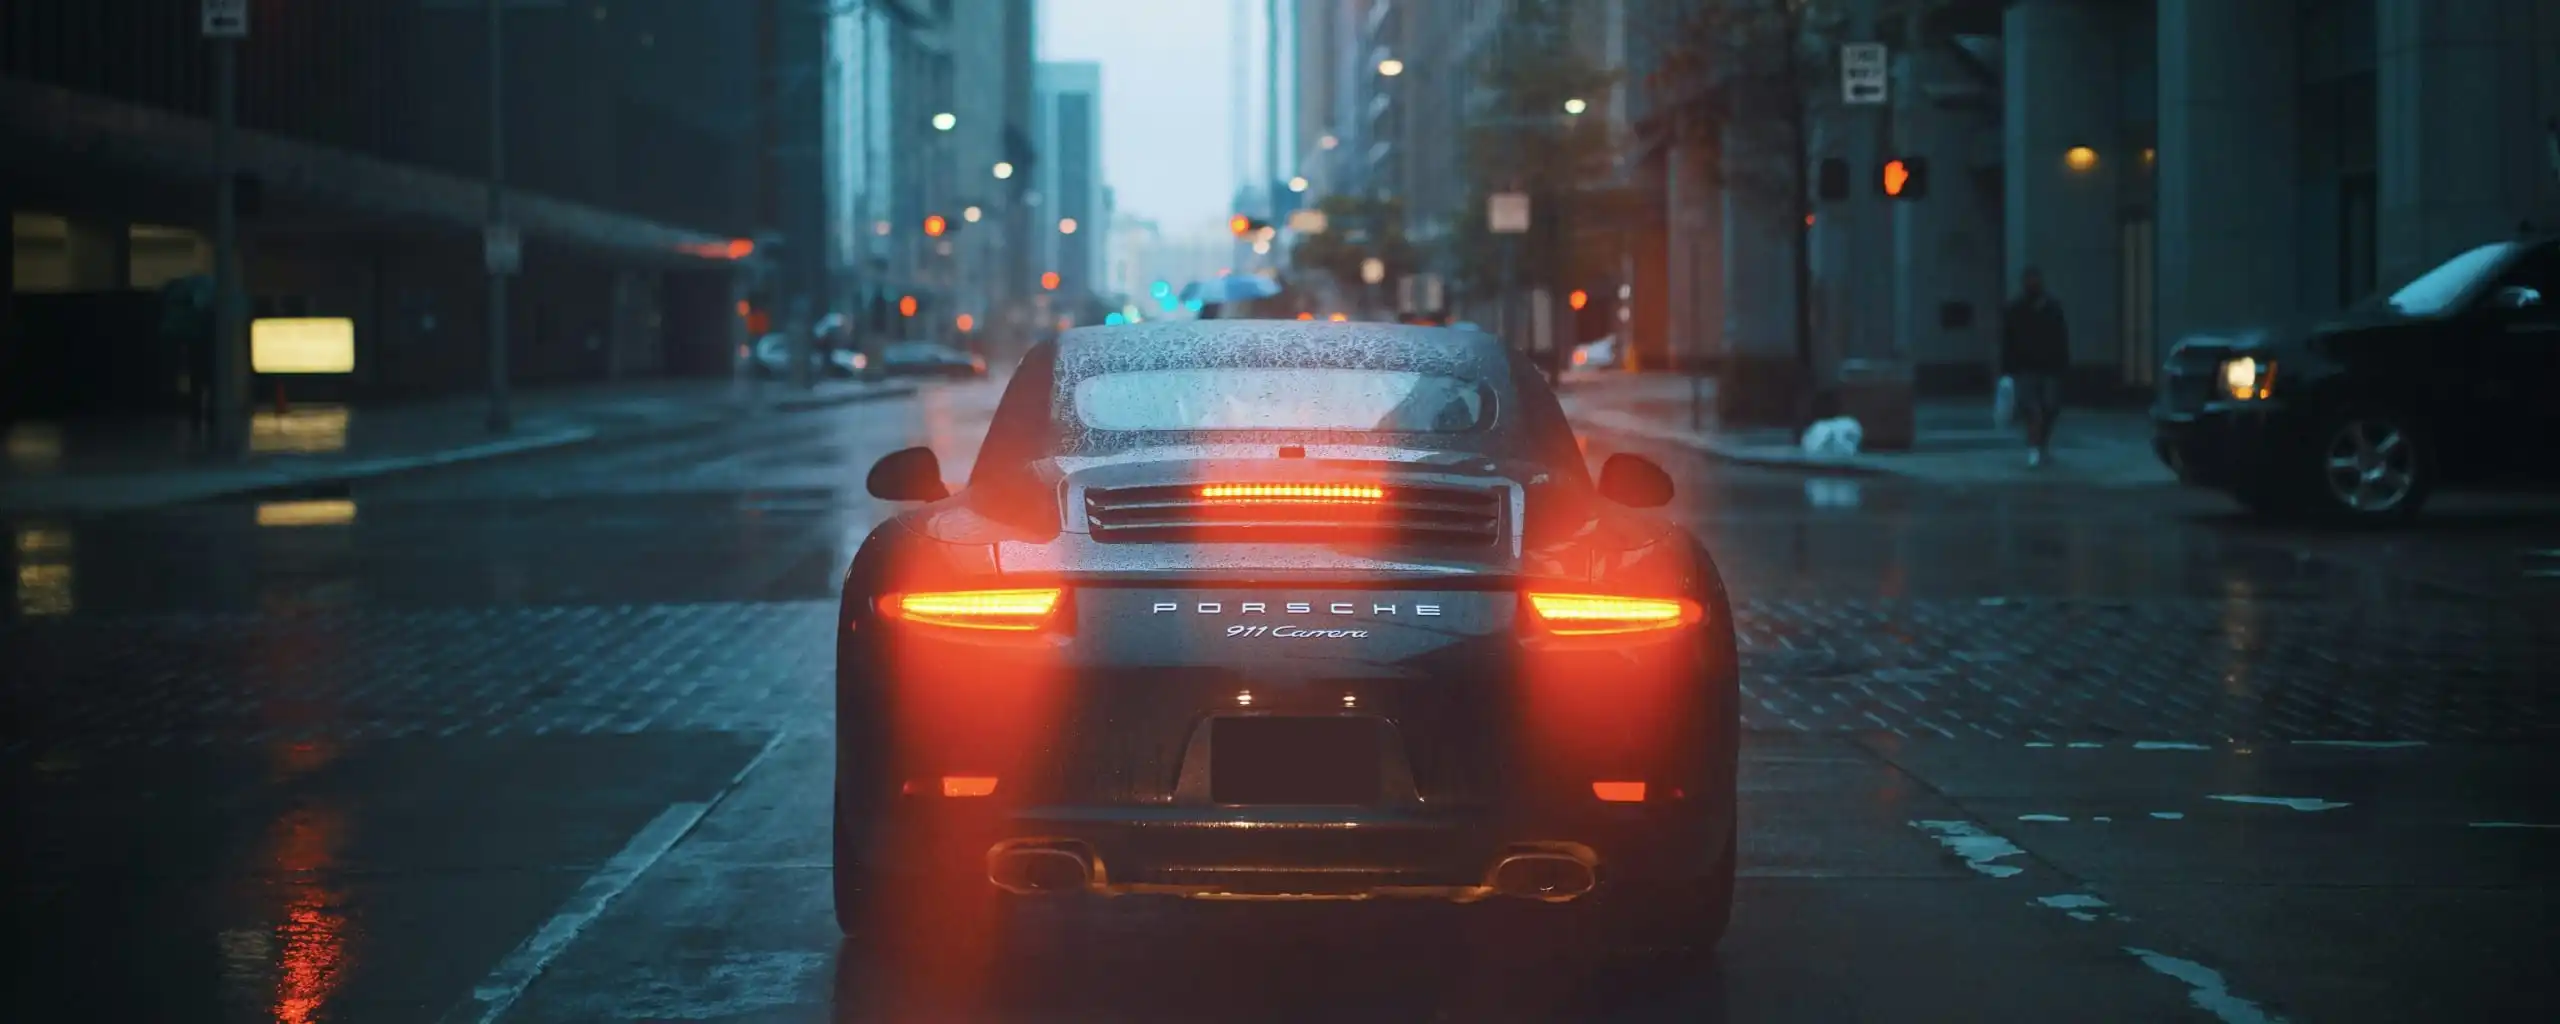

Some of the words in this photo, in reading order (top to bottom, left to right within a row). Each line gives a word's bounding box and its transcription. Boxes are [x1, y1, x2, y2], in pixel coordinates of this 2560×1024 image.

[1153, 602, 1441, 616] PORSCHE
[1226, 625, 1269, 637] 911
[1272, 625, 1368, 638] Carrera
